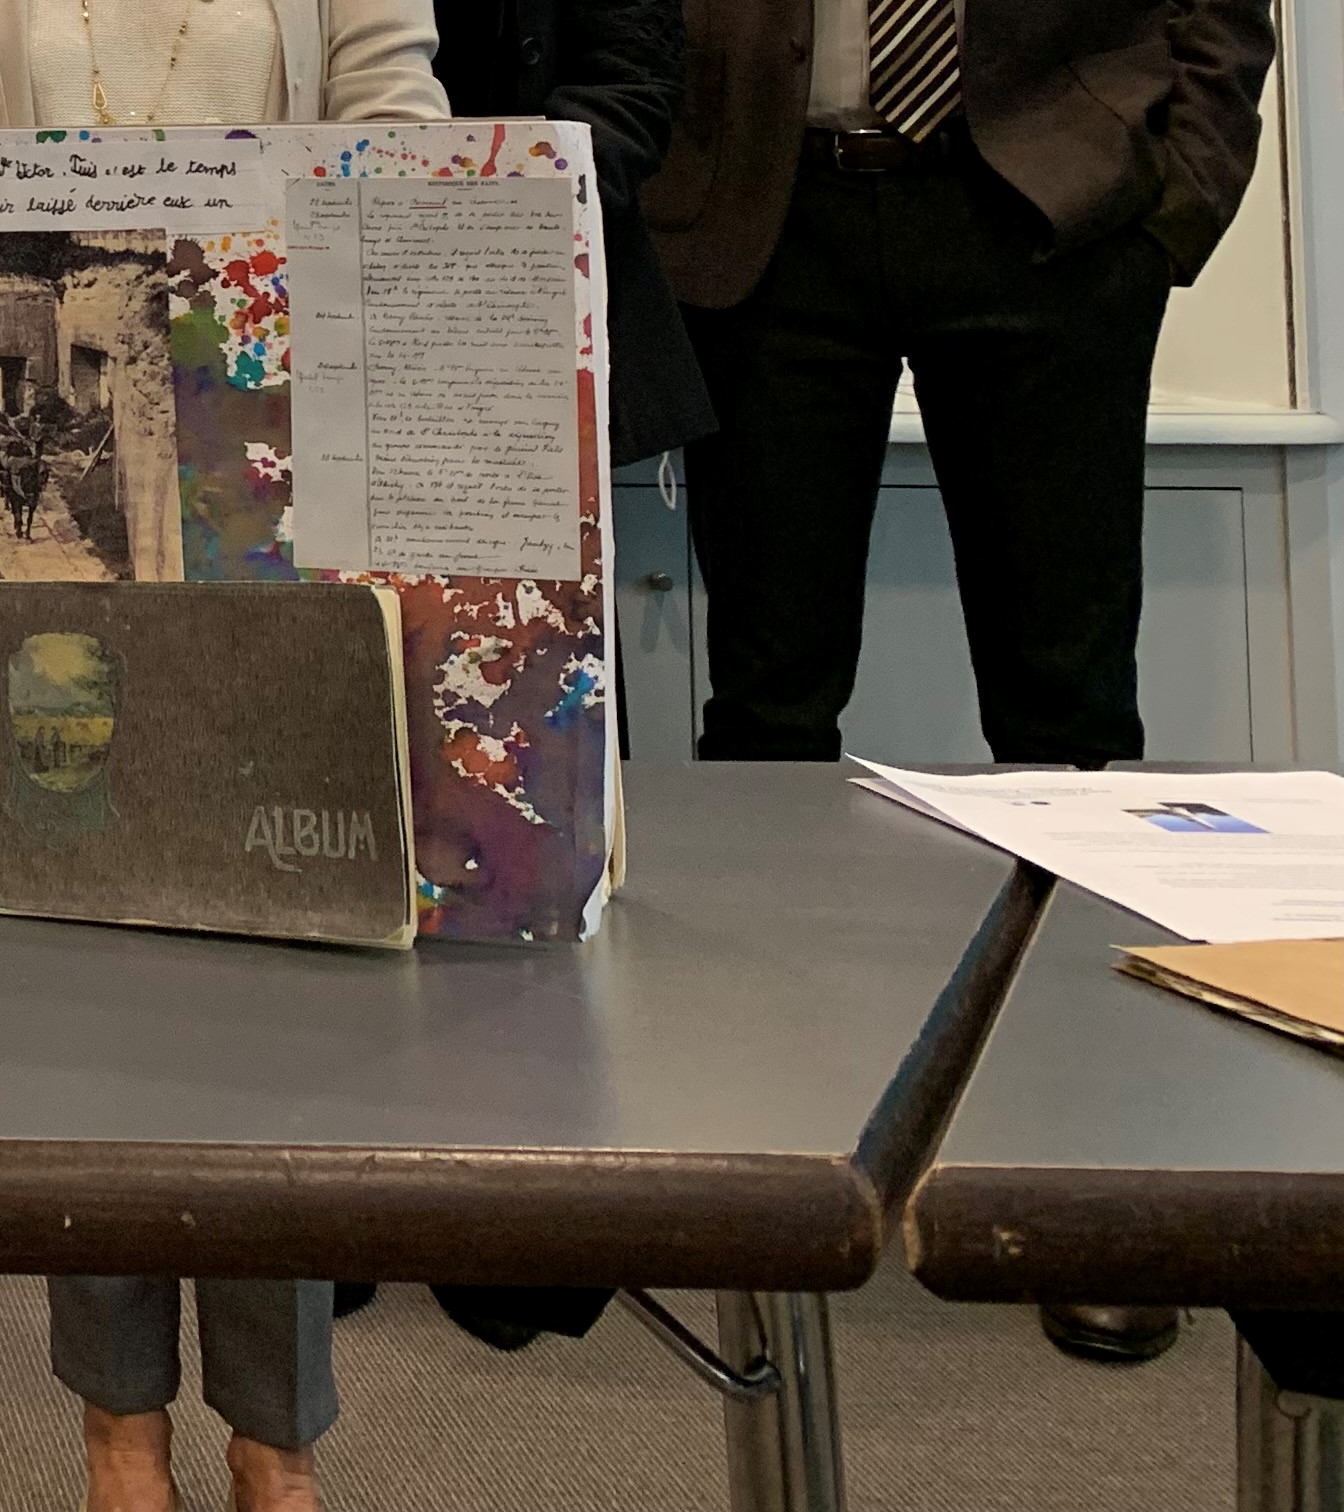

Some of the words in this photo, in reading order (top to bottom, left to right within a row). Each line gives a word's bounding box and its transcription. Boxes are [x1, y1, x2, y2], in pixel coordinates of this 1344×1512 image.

[156, 158, 178, 173] le
[186, 161, 237, 178] temps
[164, 196, 193, 208] eux
[205, 197, 234, 208] un
[244, 805, 378, 873] ALBUM
